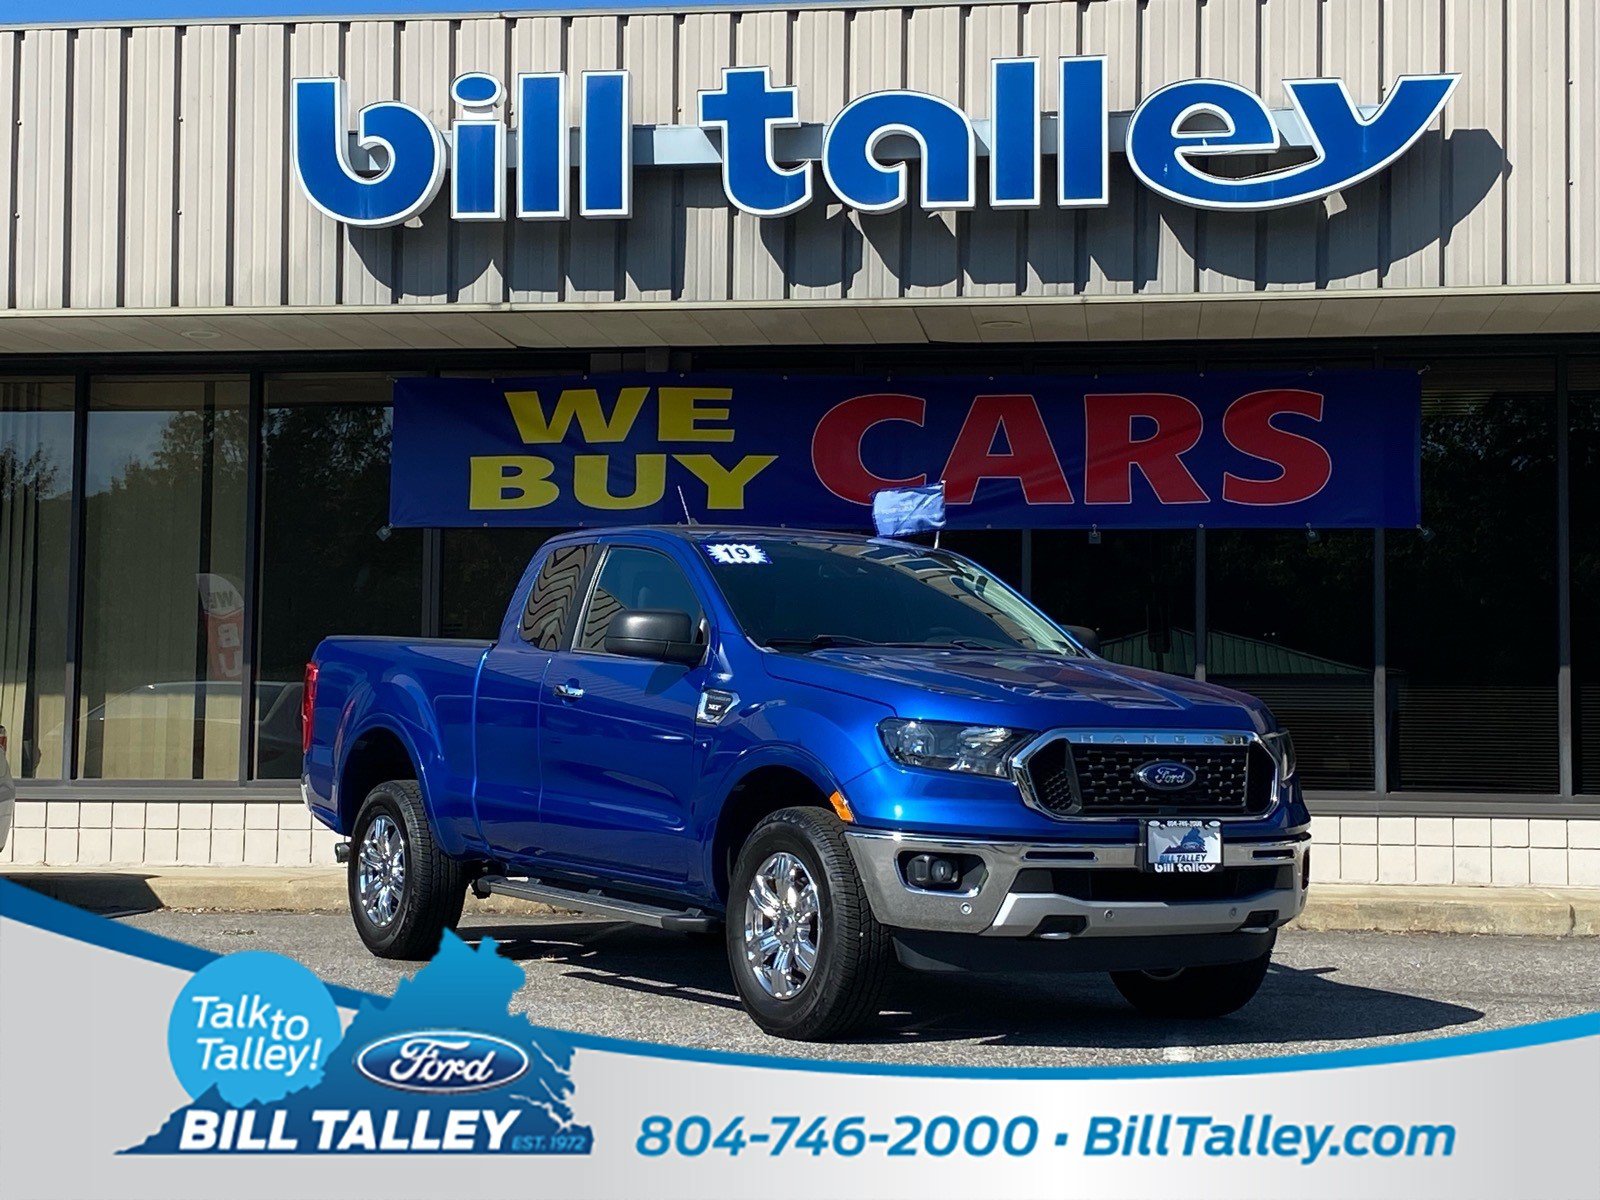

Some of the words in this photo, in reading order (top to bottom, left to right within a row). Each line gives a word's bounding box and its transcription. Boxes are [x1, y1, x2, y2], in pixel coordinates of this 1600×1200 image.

[291, 70, 632, 227] bill
[697, 55, 1462, 217] talley
[503, 386, 736, 444] WE
[811, 388, 1333, 506] CARS
[468, 454, 778, 511] BUY
[722, 547, 751, 560] 19
[1154, 766, 1186, 784] Ford
[1154, 863, 1174, 873] bill
[1177, 863, 1216, 873] talley
[1159, 854, 1175, 863] BILL
[1176, 854, 1207, 862] TALLEY
